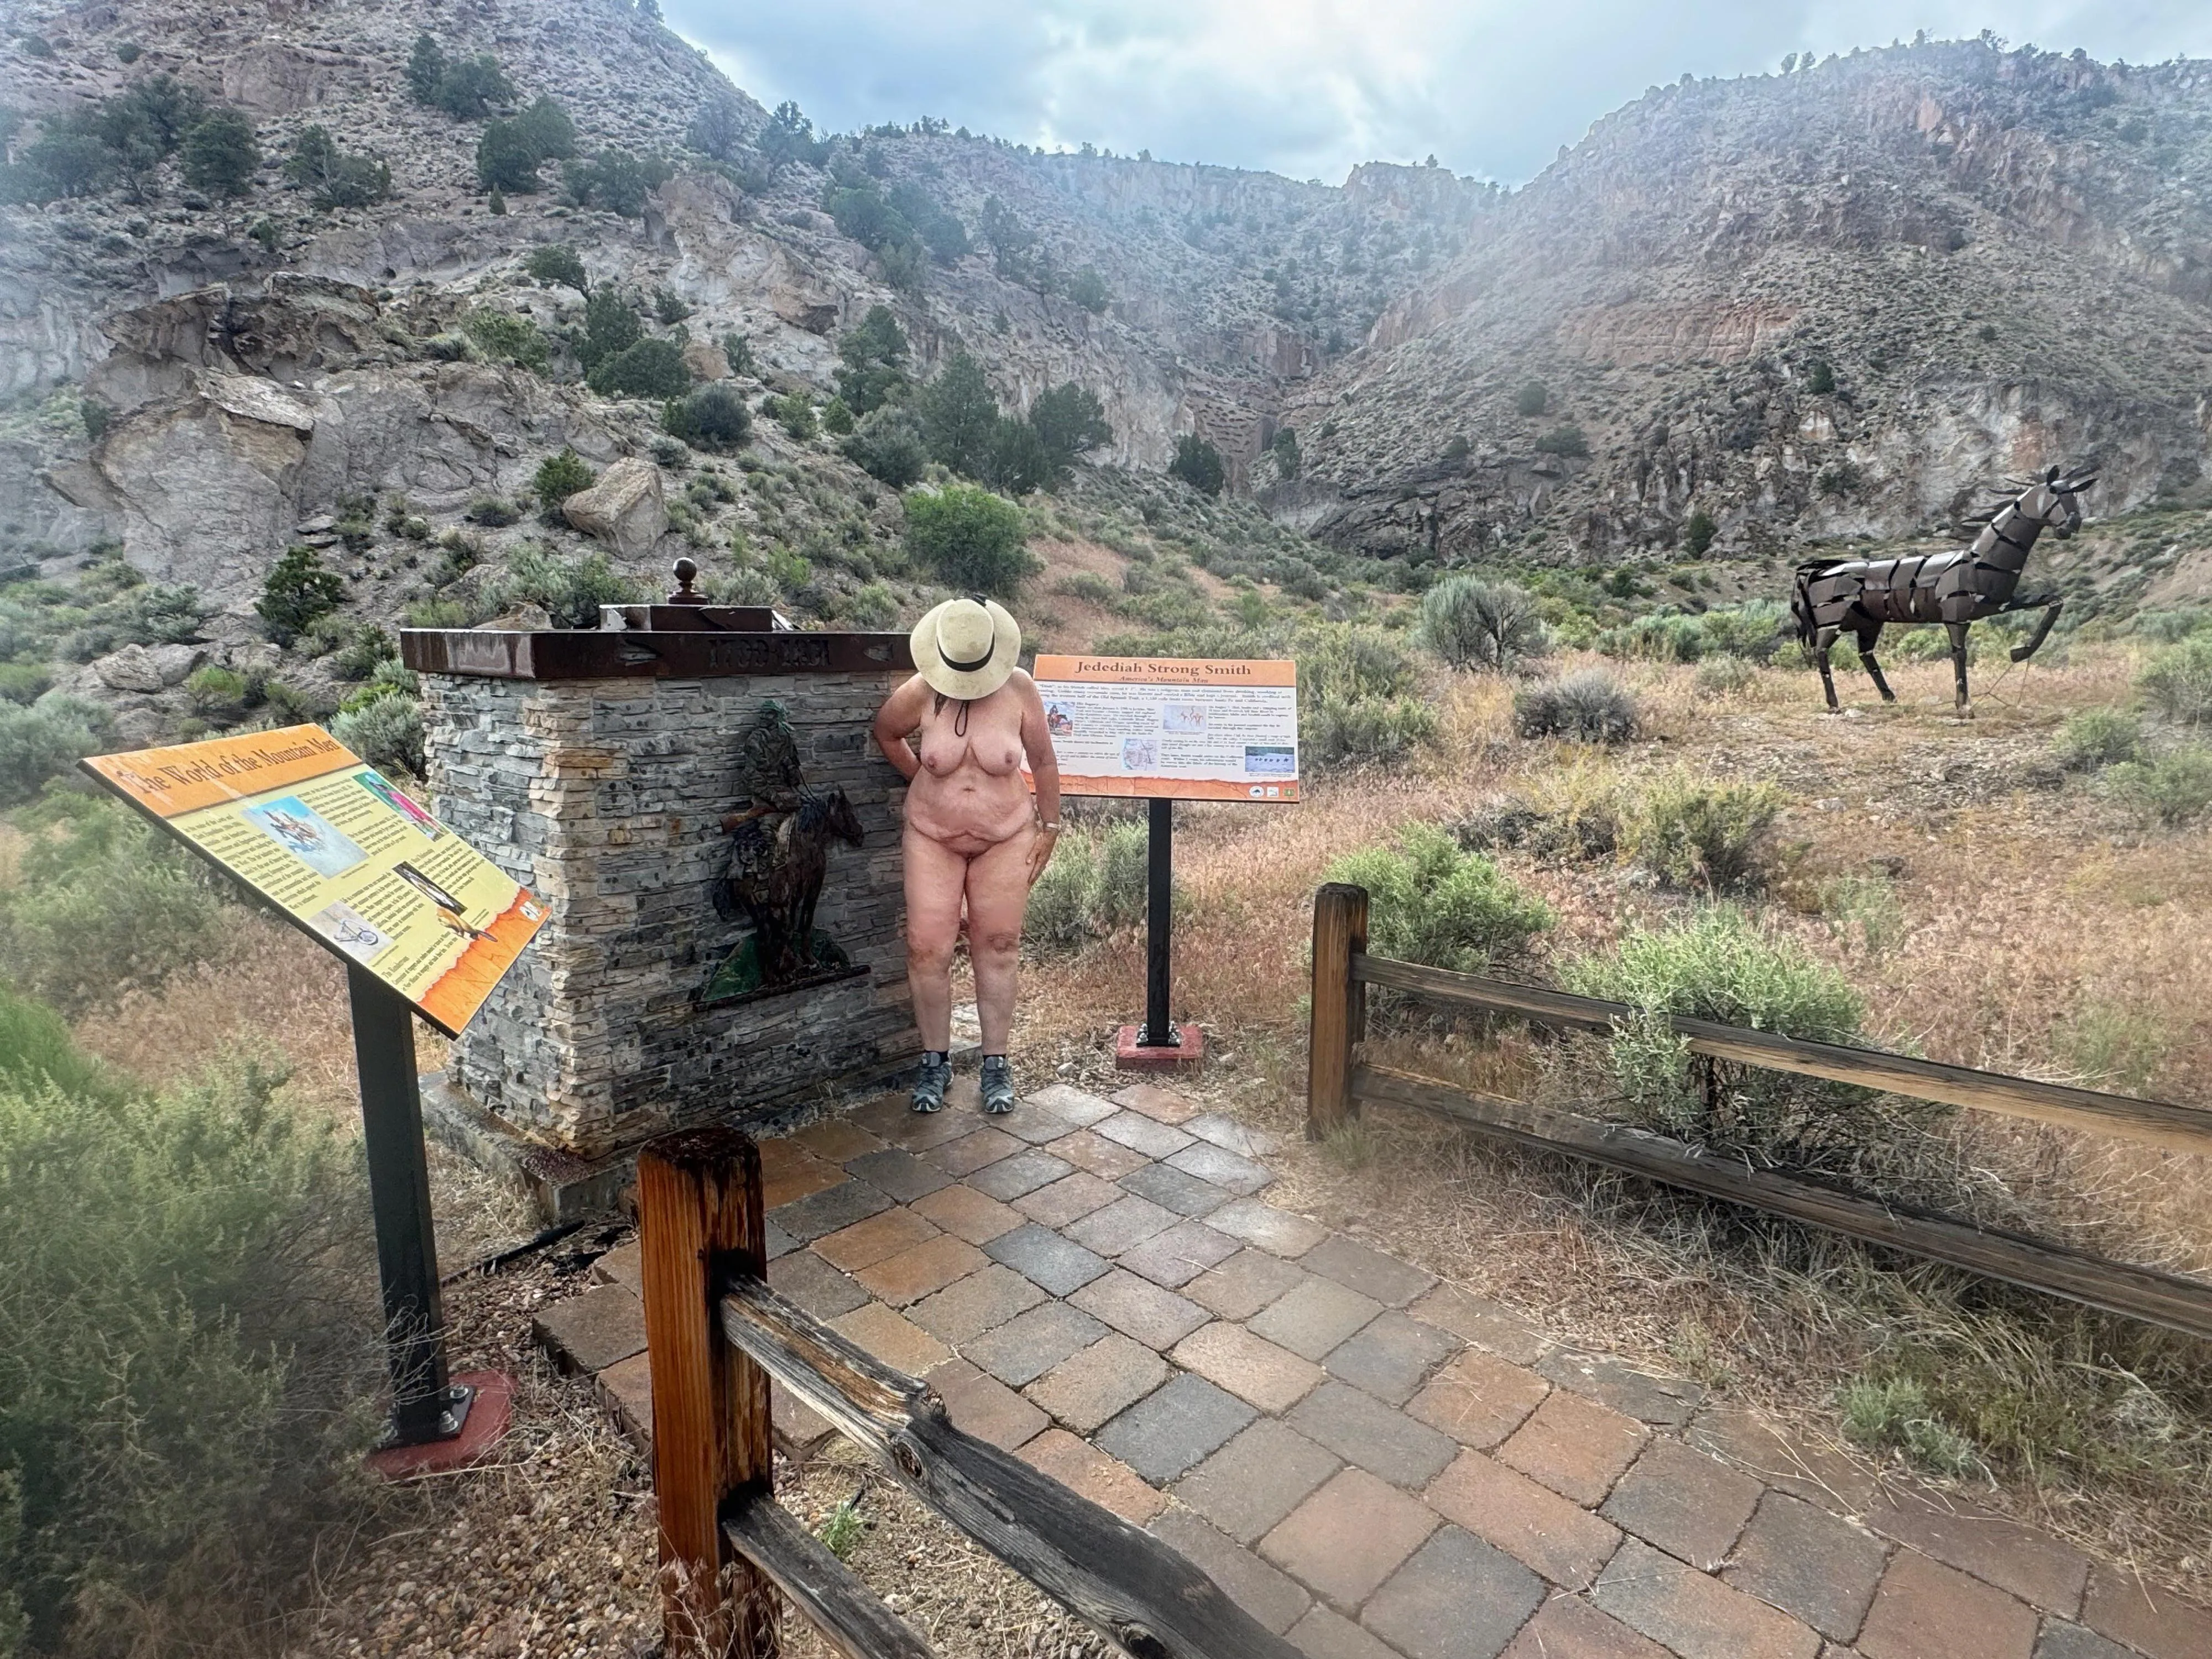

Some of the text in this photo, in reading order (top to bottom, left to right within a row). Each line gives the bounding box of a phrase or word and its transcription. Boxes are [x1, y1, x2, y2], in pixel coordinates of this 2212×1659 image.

[1074, 661, 1251, 676] Jedediah Strong Smith
[117, 737, 339, 794] The World of the Mountain Men
